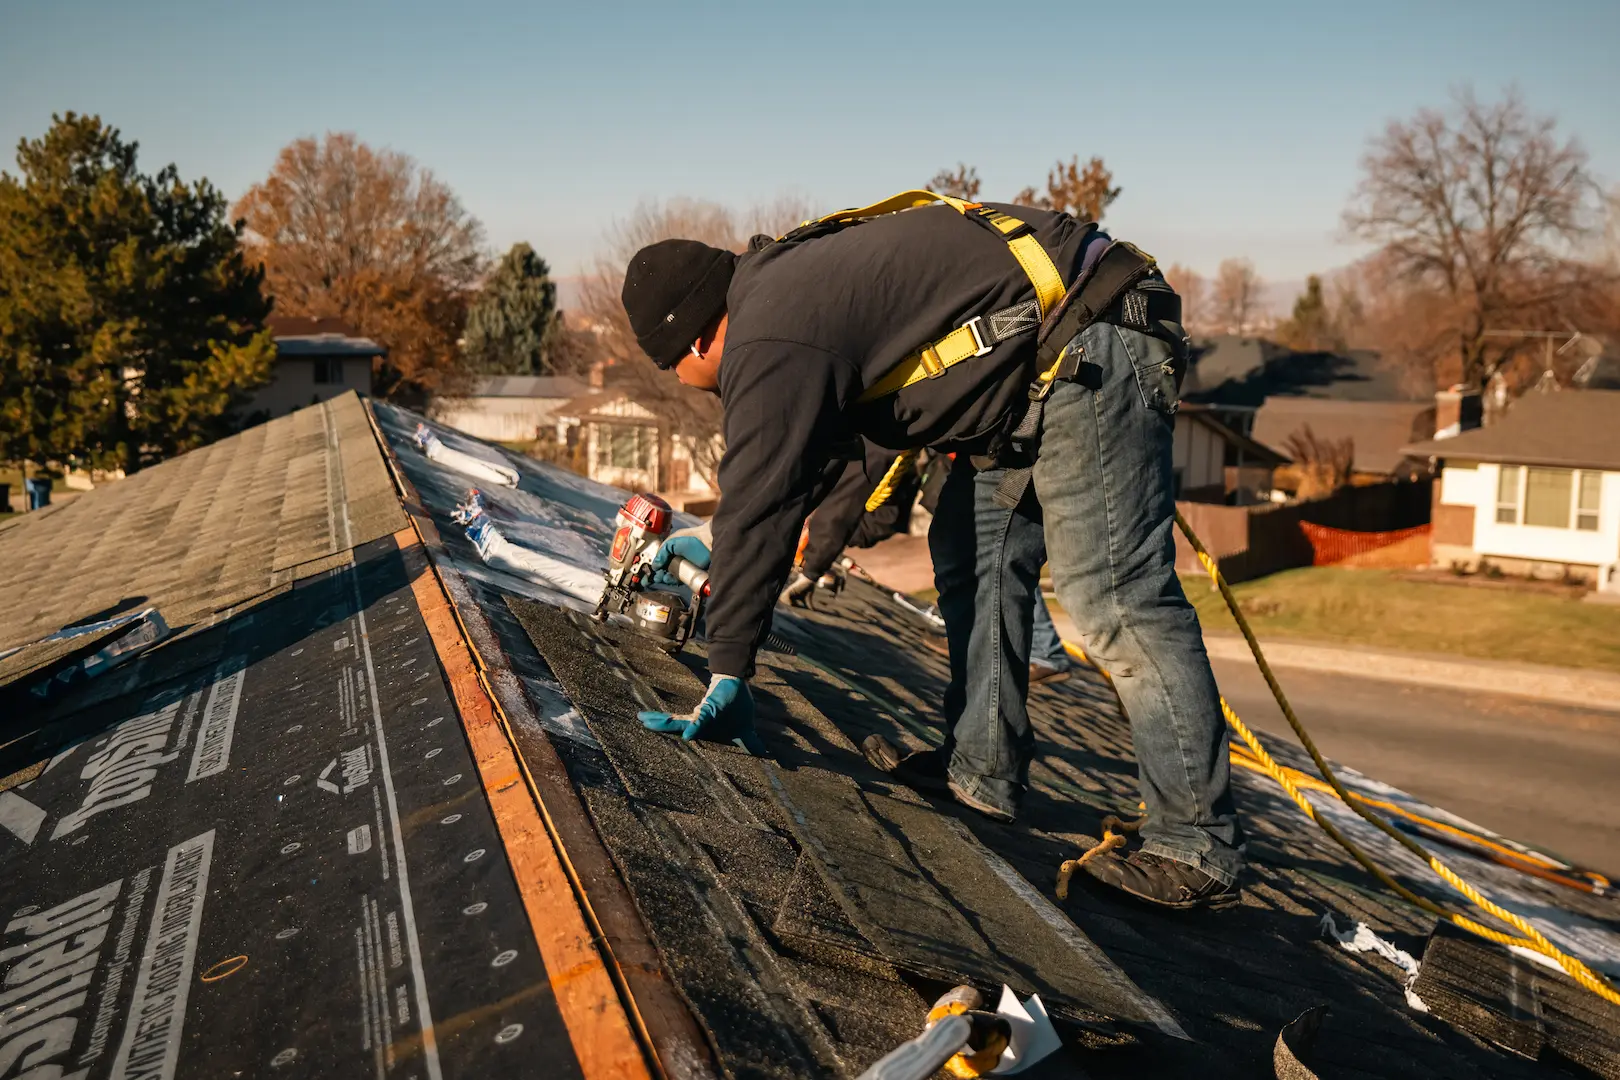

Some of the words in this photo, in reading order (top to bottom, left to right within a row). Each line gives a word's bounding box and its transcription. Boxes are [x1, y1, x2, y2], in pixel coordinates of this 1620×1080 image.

[340, 744, 374, 794] TopShield
[159, 844, 204, 939] UNDERLAYMENT
[78, 961, 132, 1065] Uncompromising
[109, 902, 142, 967] Commitment
[144, 930, 188, 1001] ROOFING
[124, 995, 177, 1080] YNTHETIC
